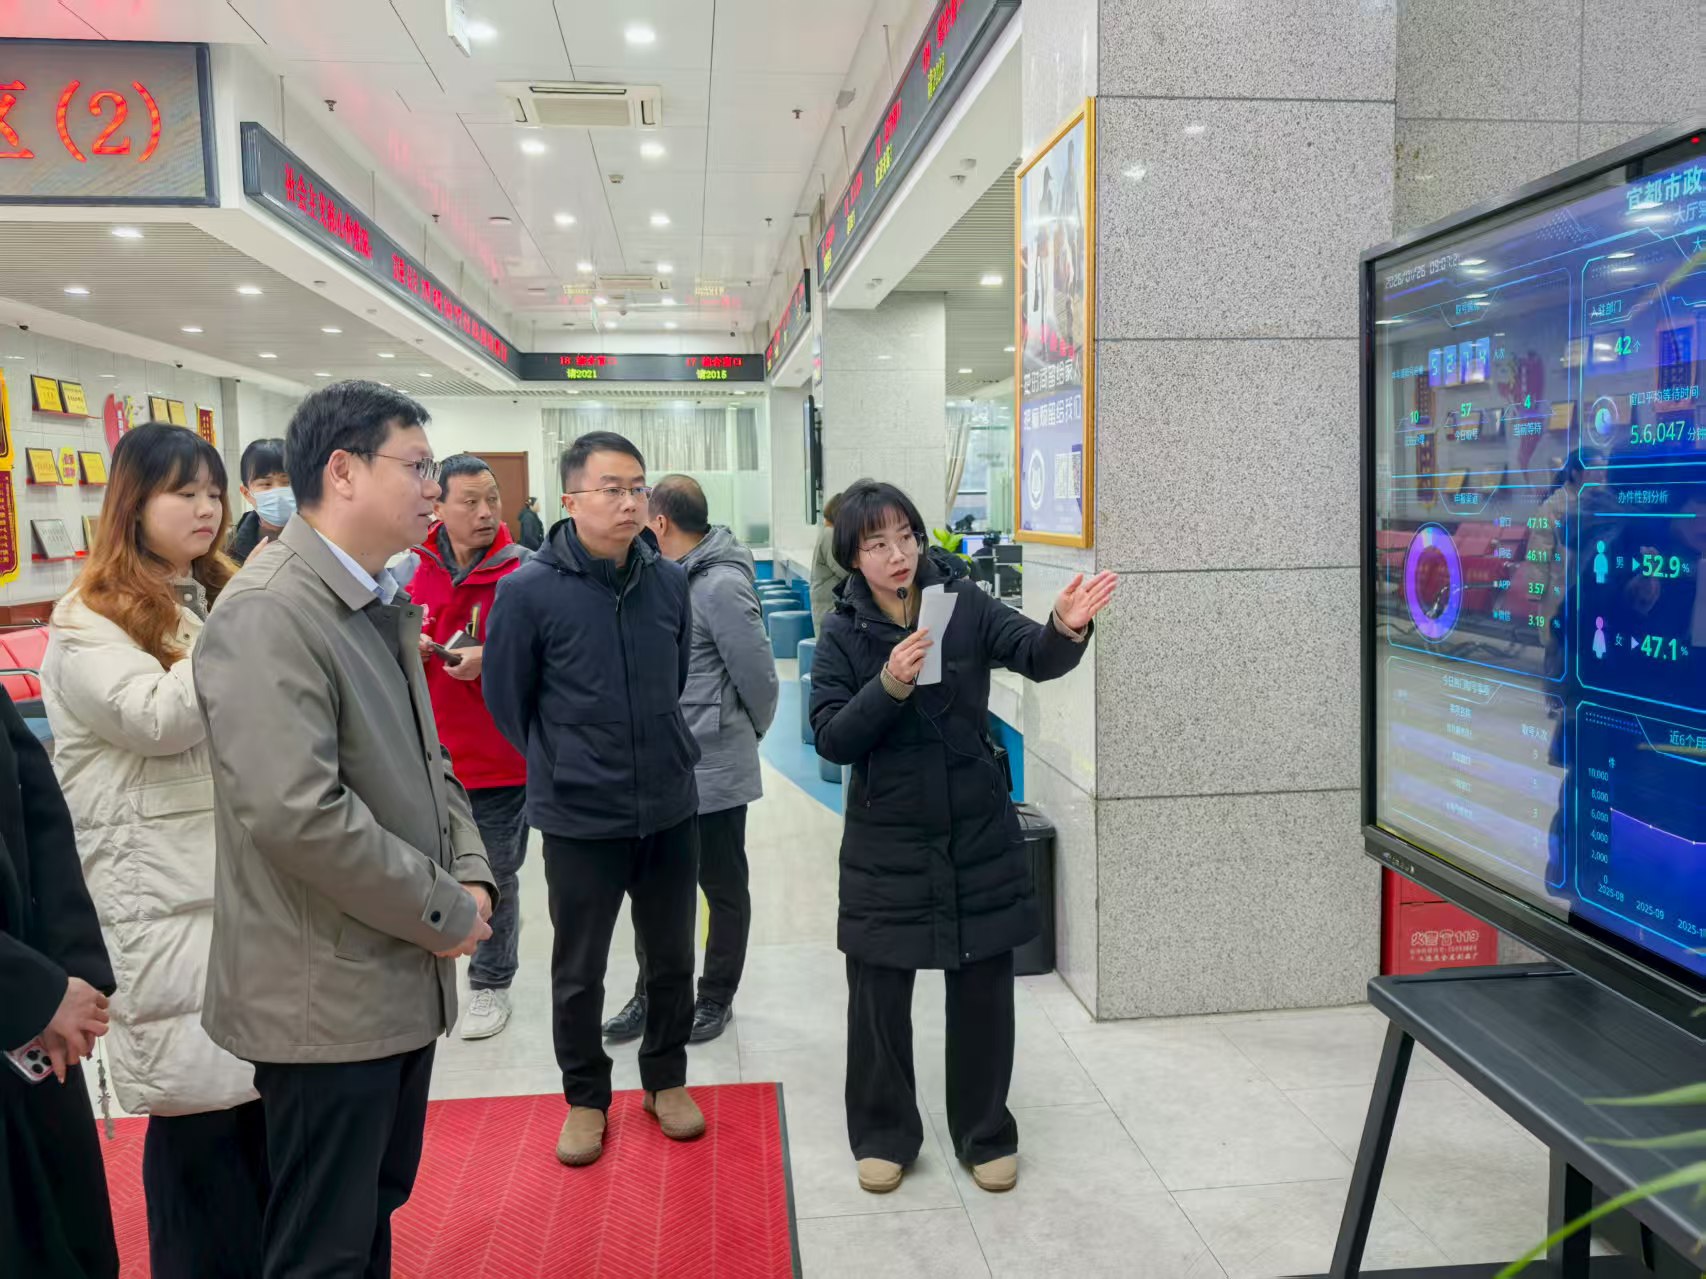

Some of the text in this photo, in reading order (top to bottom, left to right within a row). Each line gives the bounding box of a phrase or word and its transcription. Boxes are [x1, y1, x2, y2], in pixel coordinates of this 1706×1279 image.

[1523, 394, 1531, 409] 4
[1629, 385, 1699, 406] 窗口平均等待时间
[1410, 410, 1419, 424] 10
[1460, 402, 1472, 417] 57
[1618, 490, 1669, 504] 办件性别分析
[1616, 556, 1624, 569] 男
[1499, 580, 1511, 589] APP
[1615, 633, 1623, 647] 女
[1588, 767, 1609, 782] 10,000
[1591, 789, 1609, 802] 8,000
[1591, 808, 1609, 823] 6,000
[1591, 829, 1609, 844] 4,000
[1591, 850, 1609, 865] 2,000
[1603, 873, 1608, 884] 0
[1636, 900, 1665, 921] 2025-09
